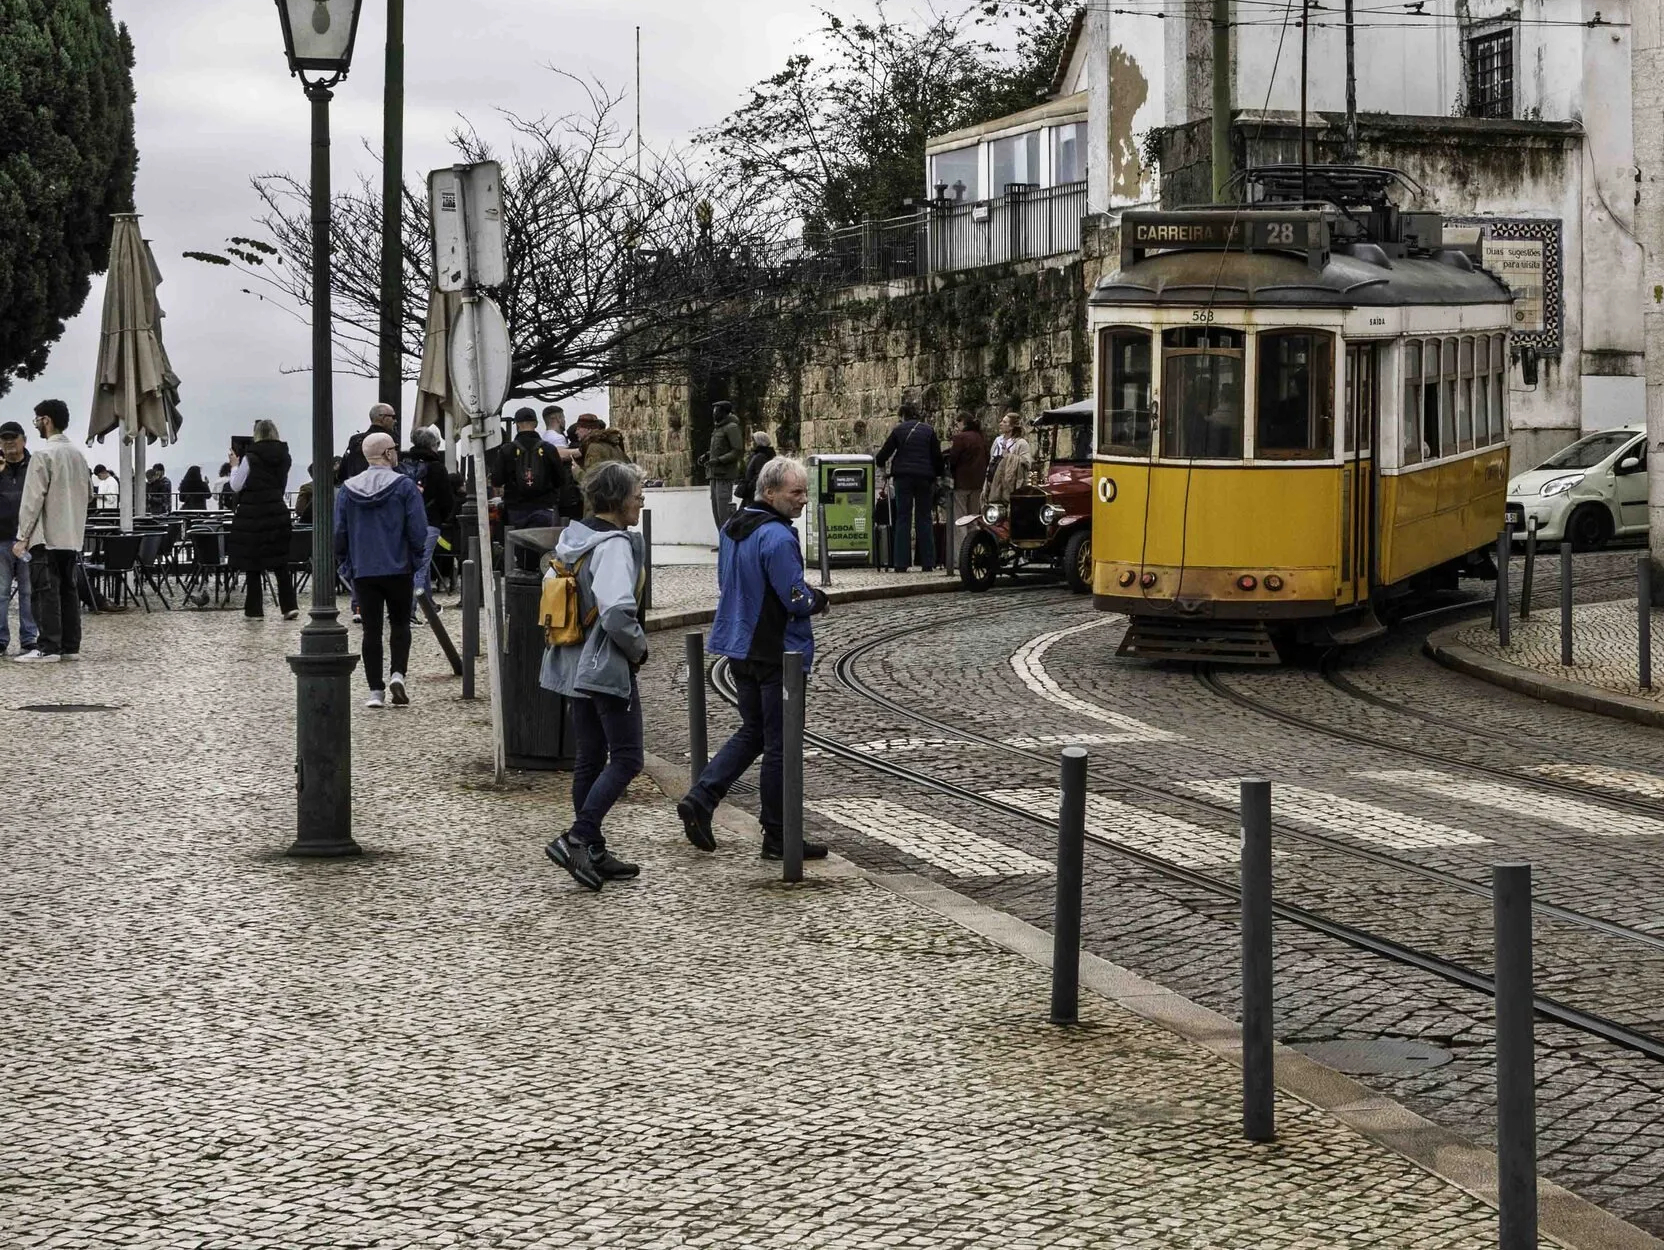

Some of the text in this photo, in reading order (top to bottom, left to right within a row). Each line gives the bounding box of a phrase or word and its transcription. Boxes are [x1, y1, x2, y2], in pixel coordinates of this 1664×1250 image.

[1137, 225, 1213, 241] CARREIRA
[1266, 222, 1294, 244] 28
[1486, 247, 1541, 259] Duas sugestões
[1503, 261, 1520, 269] para
